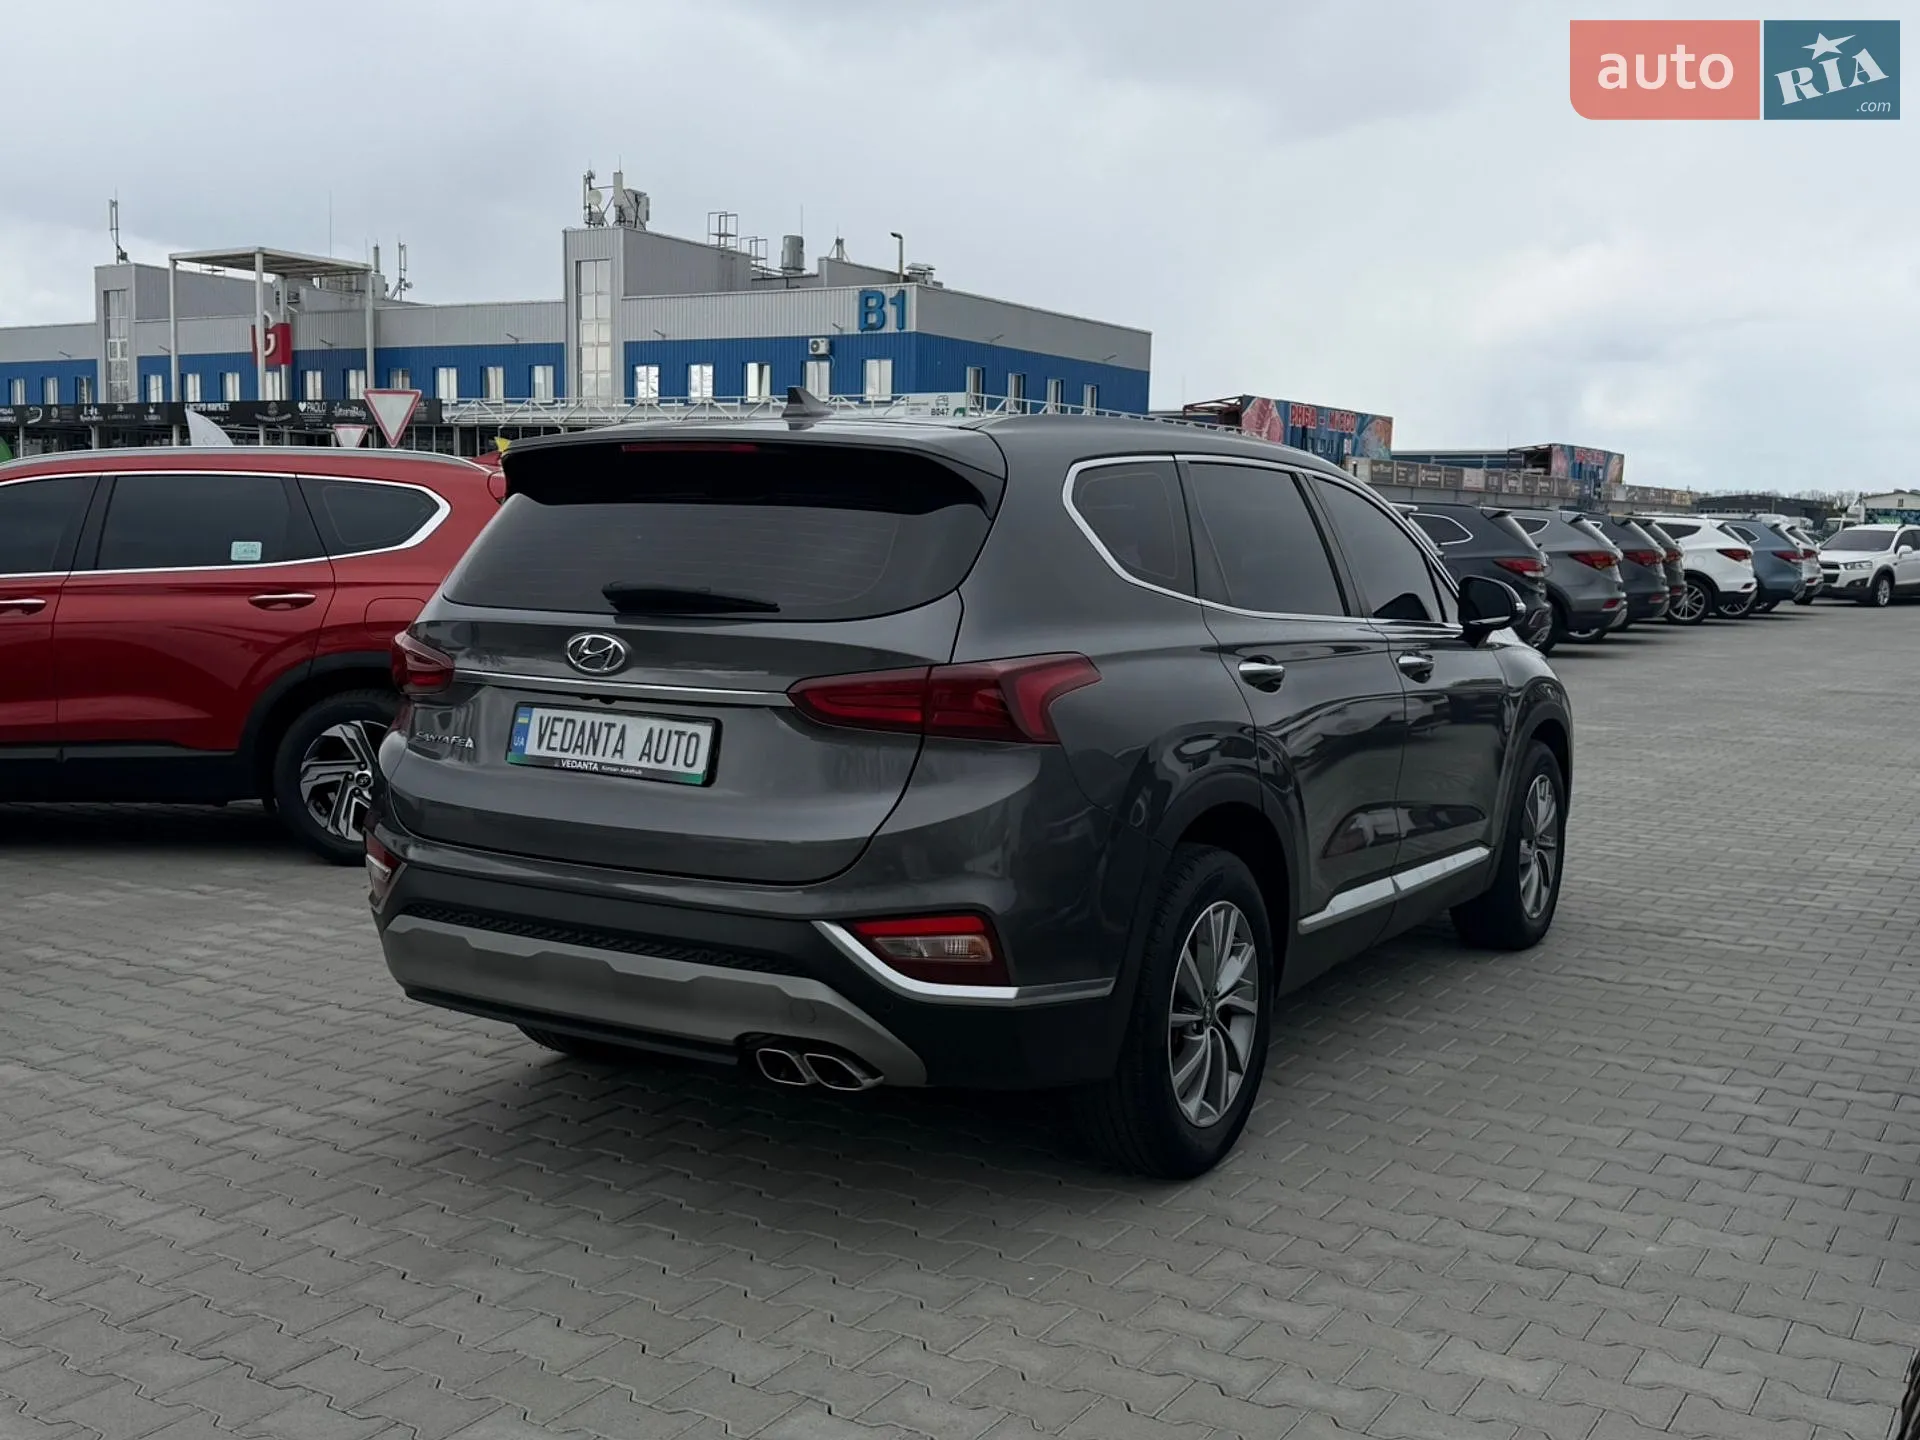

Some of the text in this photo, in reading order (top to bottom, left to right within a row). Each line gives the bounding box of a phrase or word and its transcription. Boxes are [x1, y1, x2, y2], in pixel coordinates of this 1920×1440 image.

[858, 288, 905, 332] B1
[536, 715, 702, 769] VEDANTA AUTO
[560, 759, 599, 772] VEDANTA
